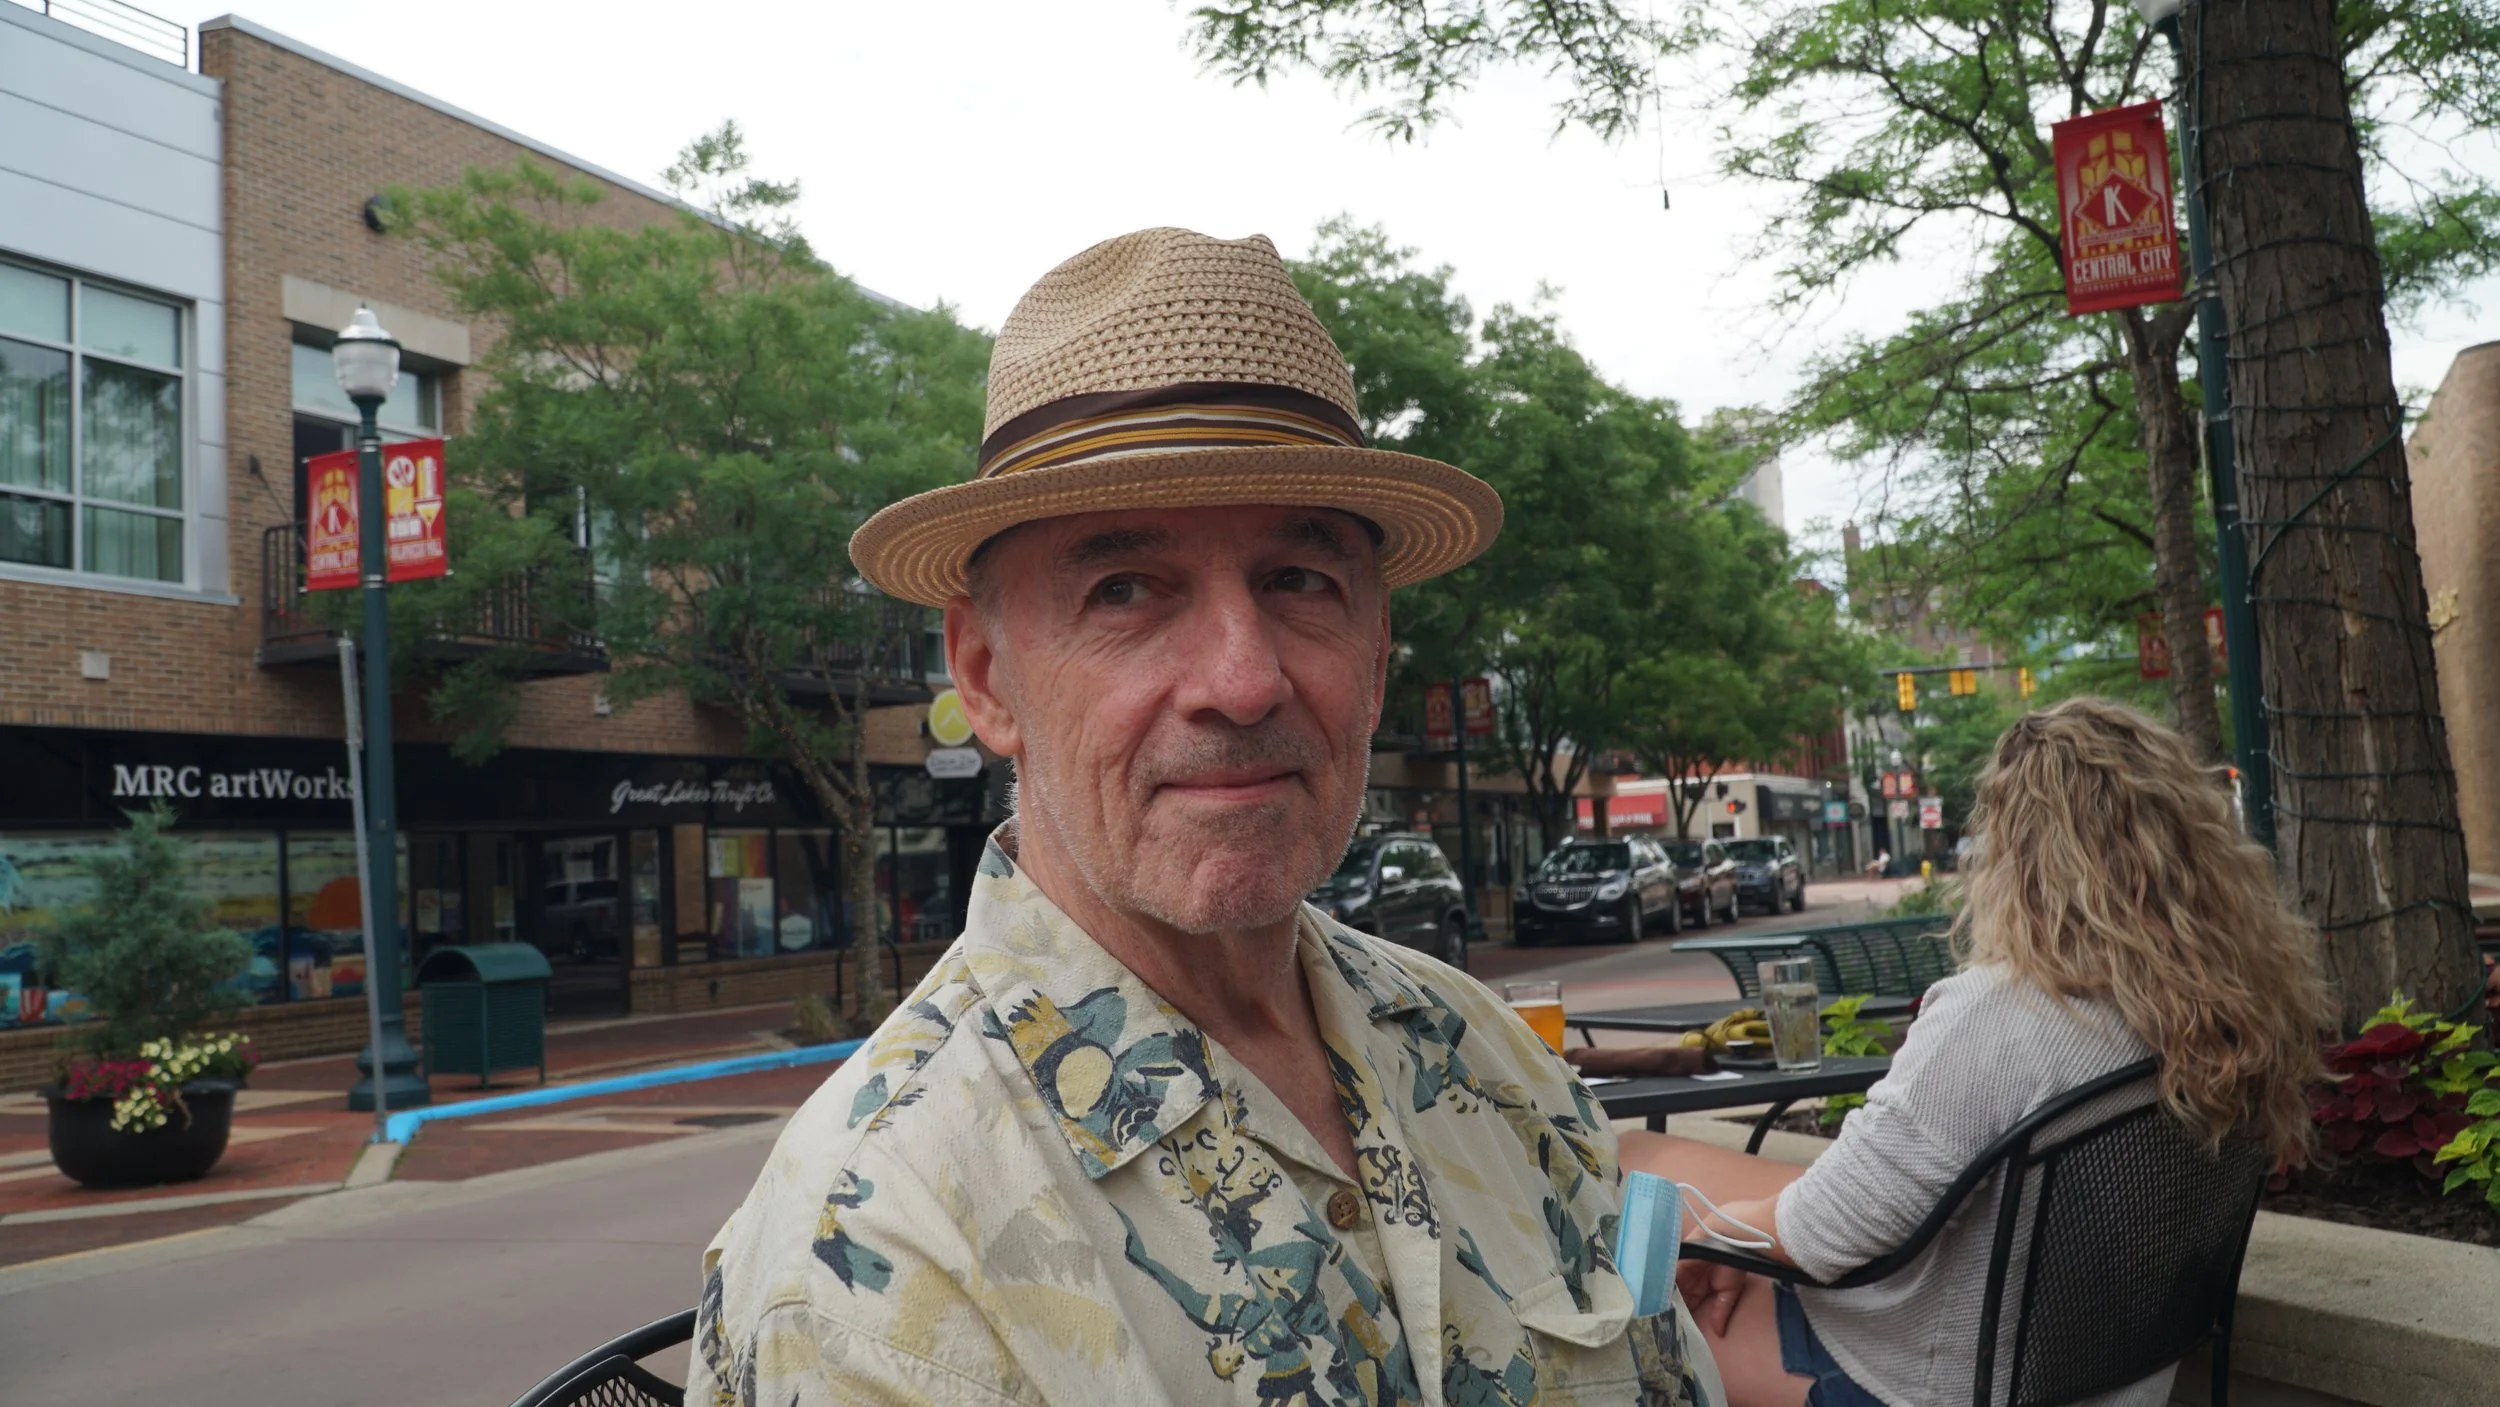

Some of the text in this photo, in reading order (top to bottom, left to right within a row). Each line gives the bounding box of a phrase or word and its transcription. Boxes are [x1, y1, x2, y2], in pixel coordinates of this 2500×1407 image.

[2103, 184, 2131, 226] K
[2072, 251, 2137, 284] CENTRAL
[2141, 246, 2171, 273] CITY
[112, 764, 355, 799] MRC artWorks
[609, 779, 667, 815] Great
[660, 779, 710, 806] Lakes
